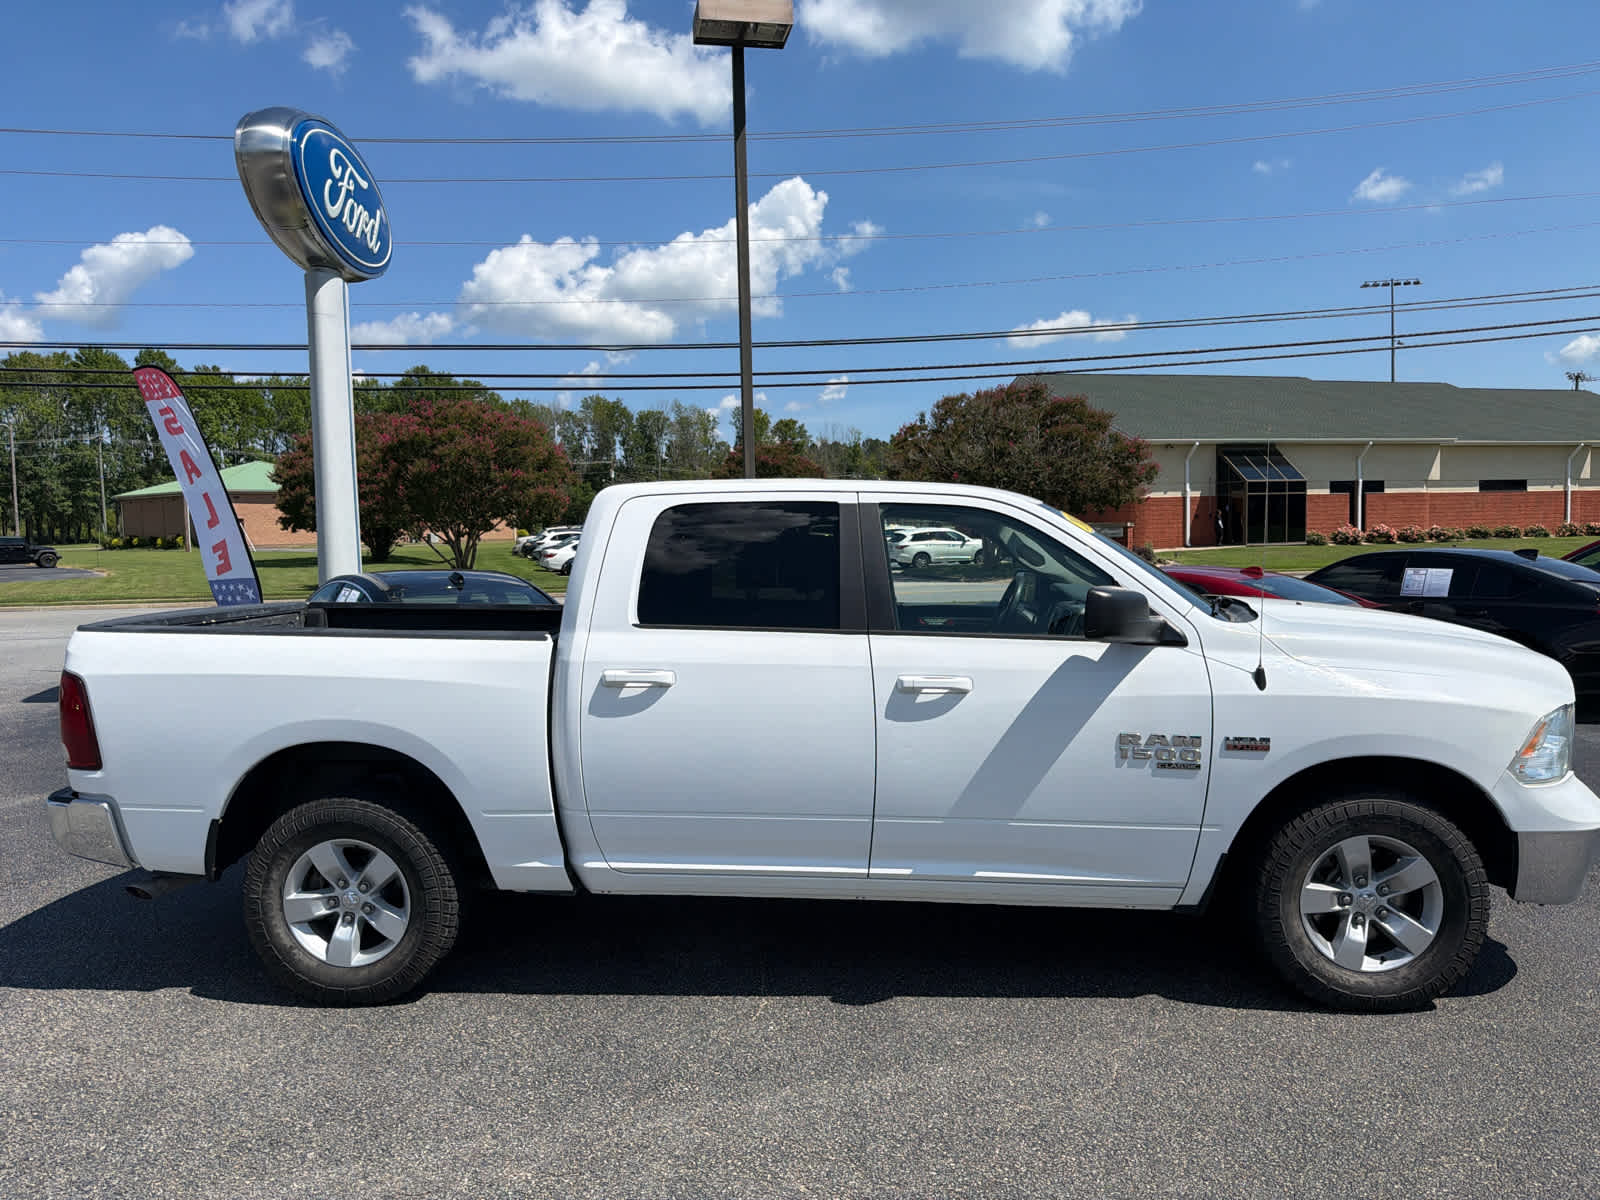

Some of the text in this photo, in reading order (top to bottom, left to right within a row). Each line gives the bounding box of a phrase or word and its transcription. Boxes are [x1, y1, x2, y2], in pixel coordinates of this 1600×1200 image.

[324, 148, 381, 255] Ford
[1119, 732, 1202, 747] RAM
[1119, 746, 1202, 761] 1500
